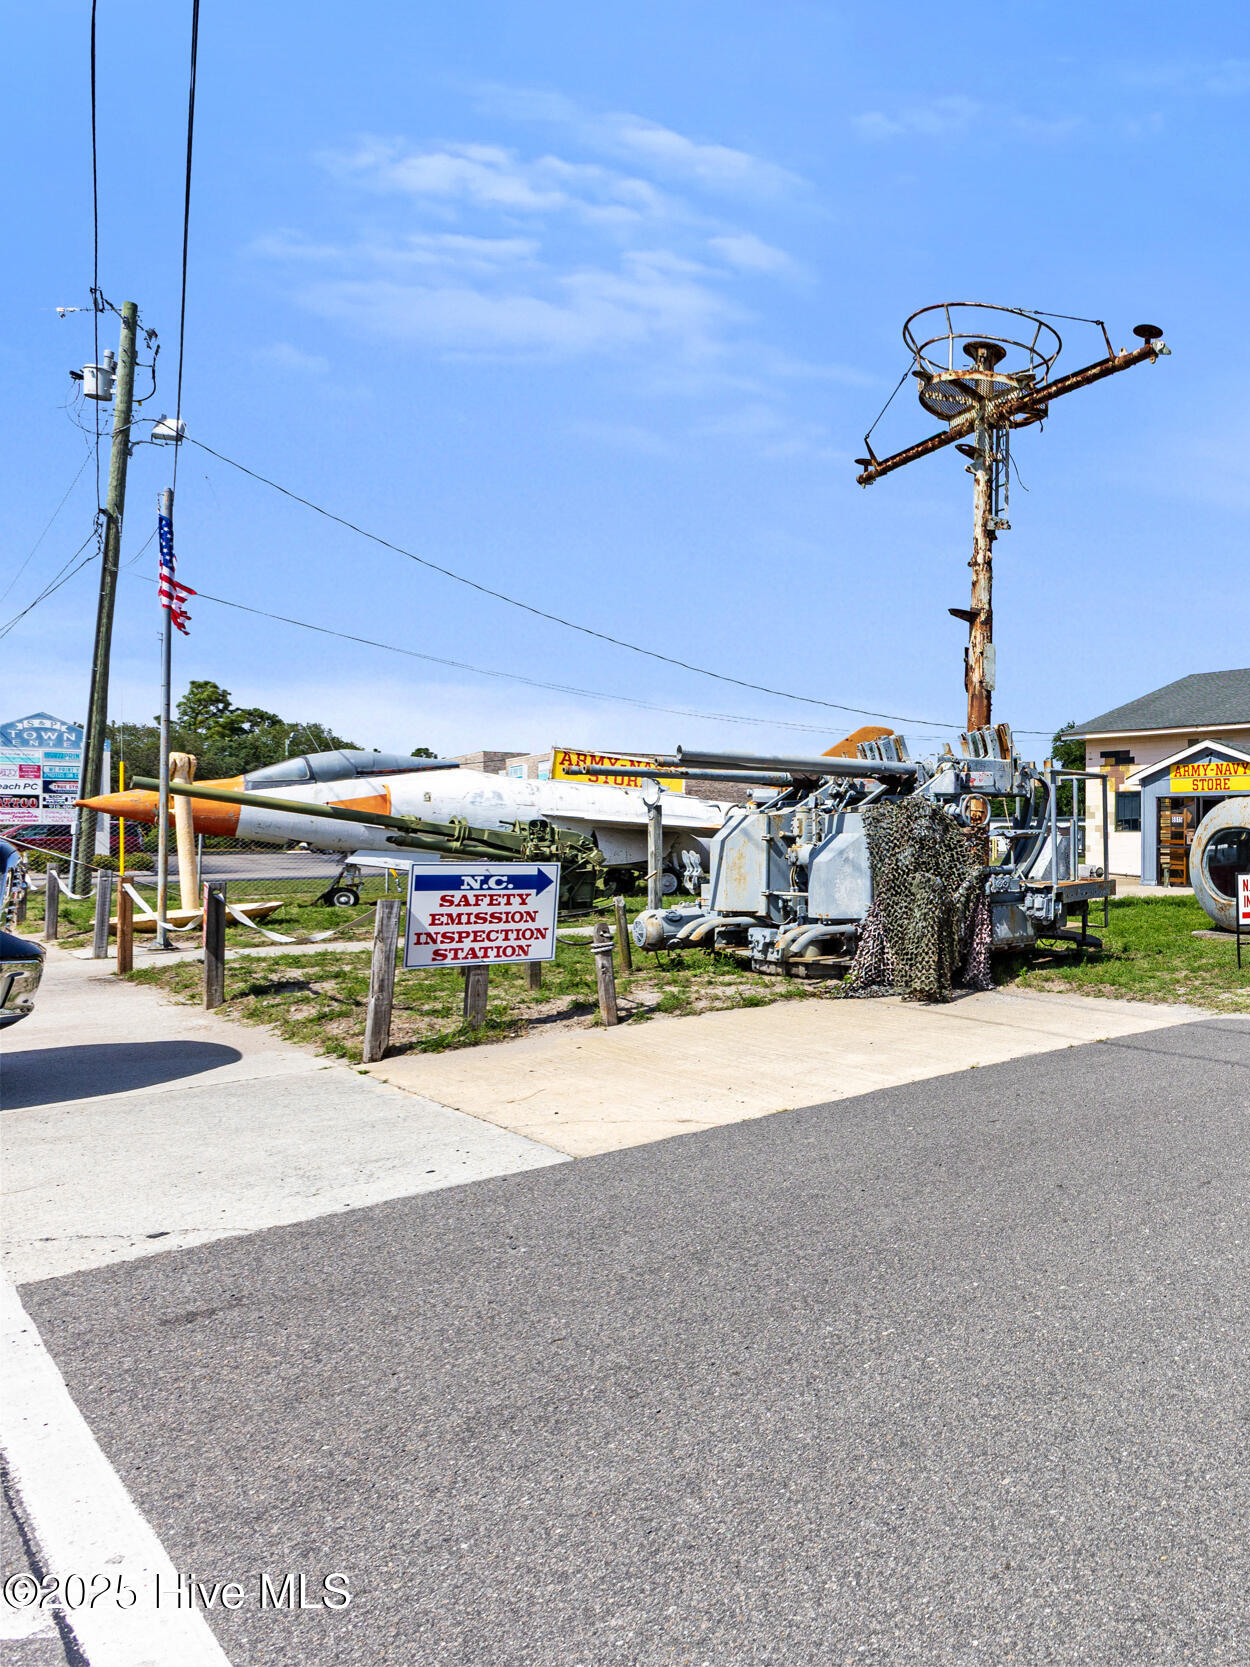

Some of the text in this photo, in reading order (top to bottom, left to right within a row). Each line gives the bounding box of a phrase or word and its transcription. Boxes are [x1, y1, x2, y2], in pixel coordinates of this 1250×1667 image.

[8, 730, 75, 741] TOWN
[12, 740, 82, 748] ENTE
[1174, 762, 1249, 777] ARMY-NAVY
[1192, 778, 1231, 791] STORE
[460, 875, 514, 889] N.C.
[439, 893, 532, 908] SAFETY
[428, 910, 539, 927] EMISSION
[413, 927, 549, 946] INSPECTION
[431, 944, 532, 962] STATION
